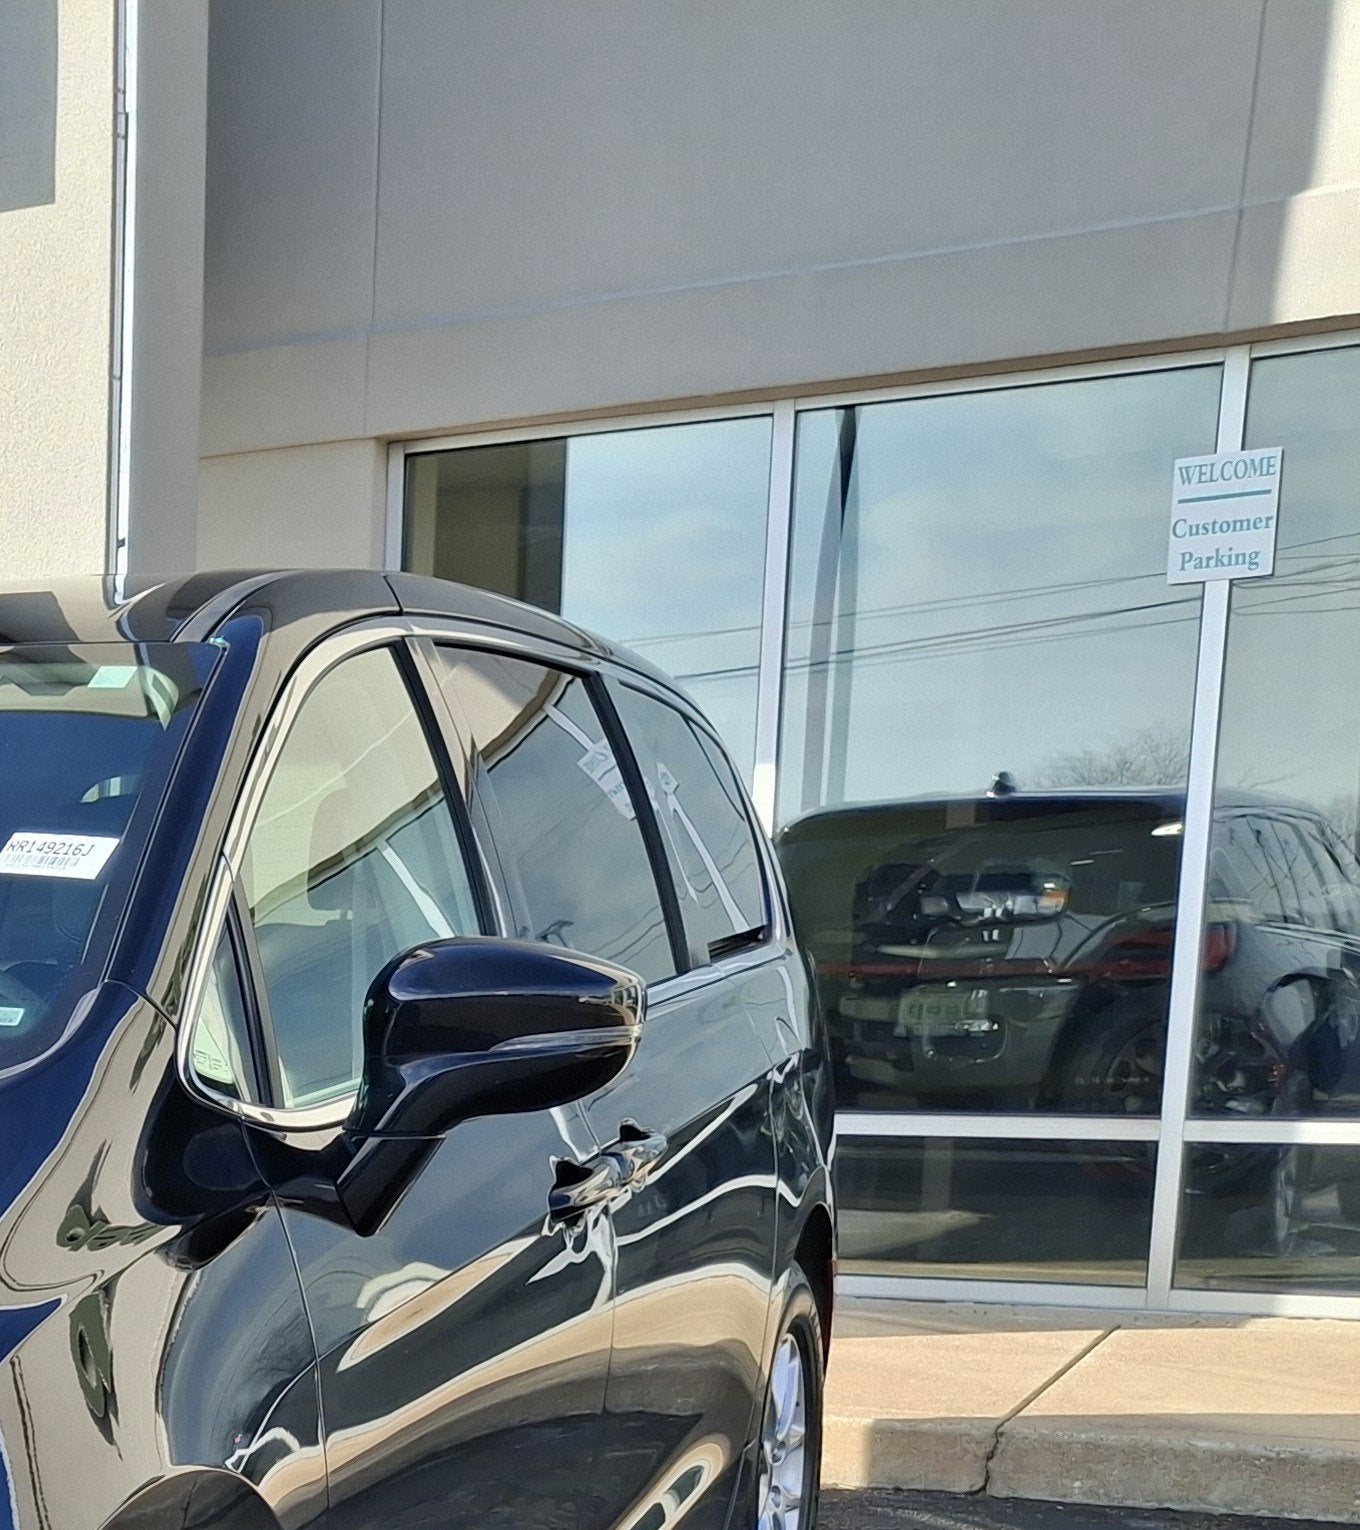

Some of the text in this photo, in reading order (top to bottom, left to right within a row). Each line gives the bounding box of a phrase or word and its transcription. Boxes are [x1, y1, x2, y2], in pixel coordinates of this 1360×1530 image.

[1178, 456, 1276, 485] WELCOME
[1172, 516, 1273, 538] Customer
[1179, 547, 1260, 571] Parking
